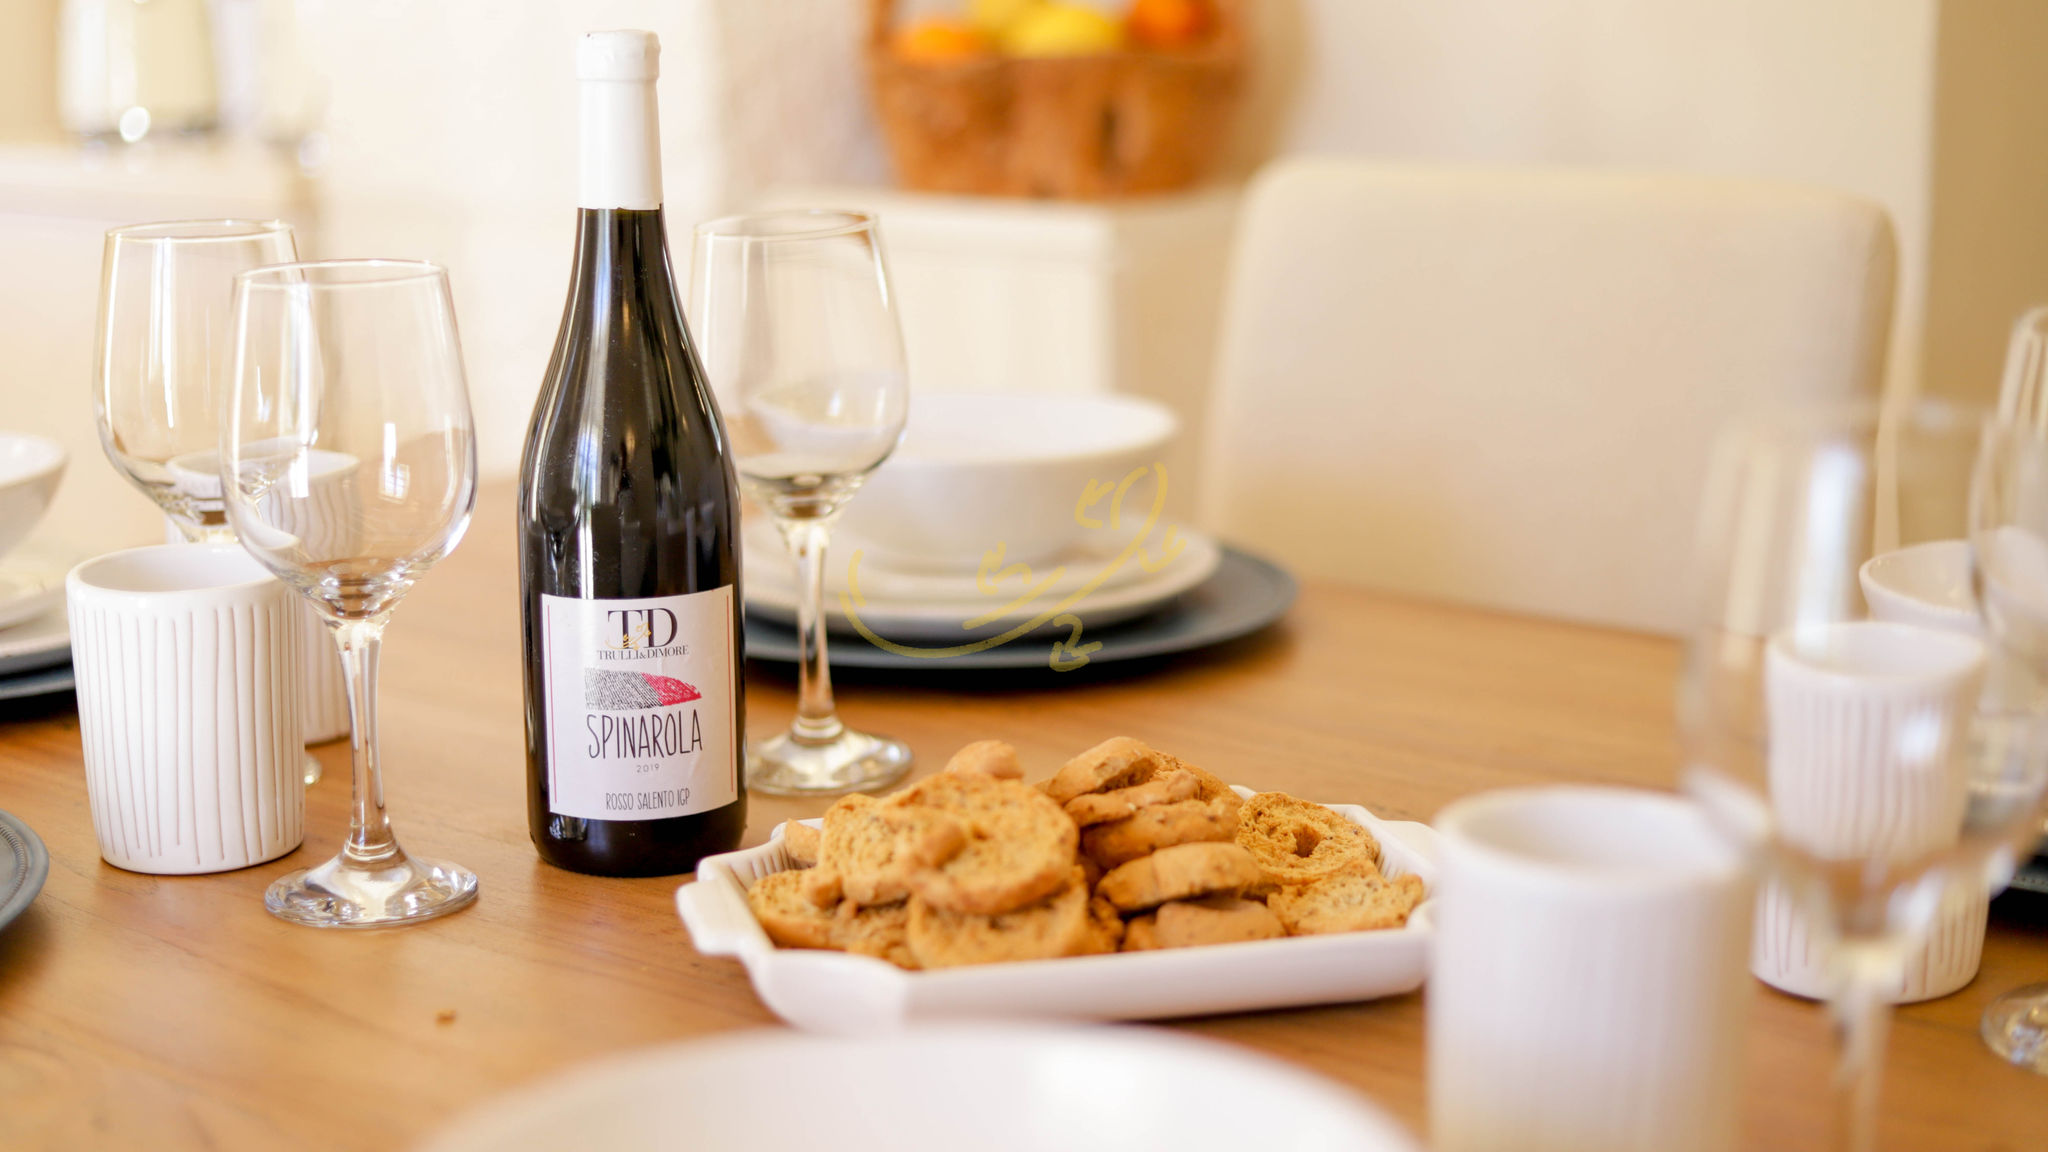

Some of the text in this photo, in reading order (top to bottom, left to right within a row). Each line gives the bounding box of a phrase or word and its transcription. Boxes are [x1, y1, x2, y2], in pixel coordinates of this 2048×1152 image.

[597, 645, 689, 661] TRULLI&DIMORE
[586, 709, 703, 759] SPINAROLA
[636, 763, 661, 774] 2019
[606, 787, 691, 811] ROSSO SALENTO IGP
